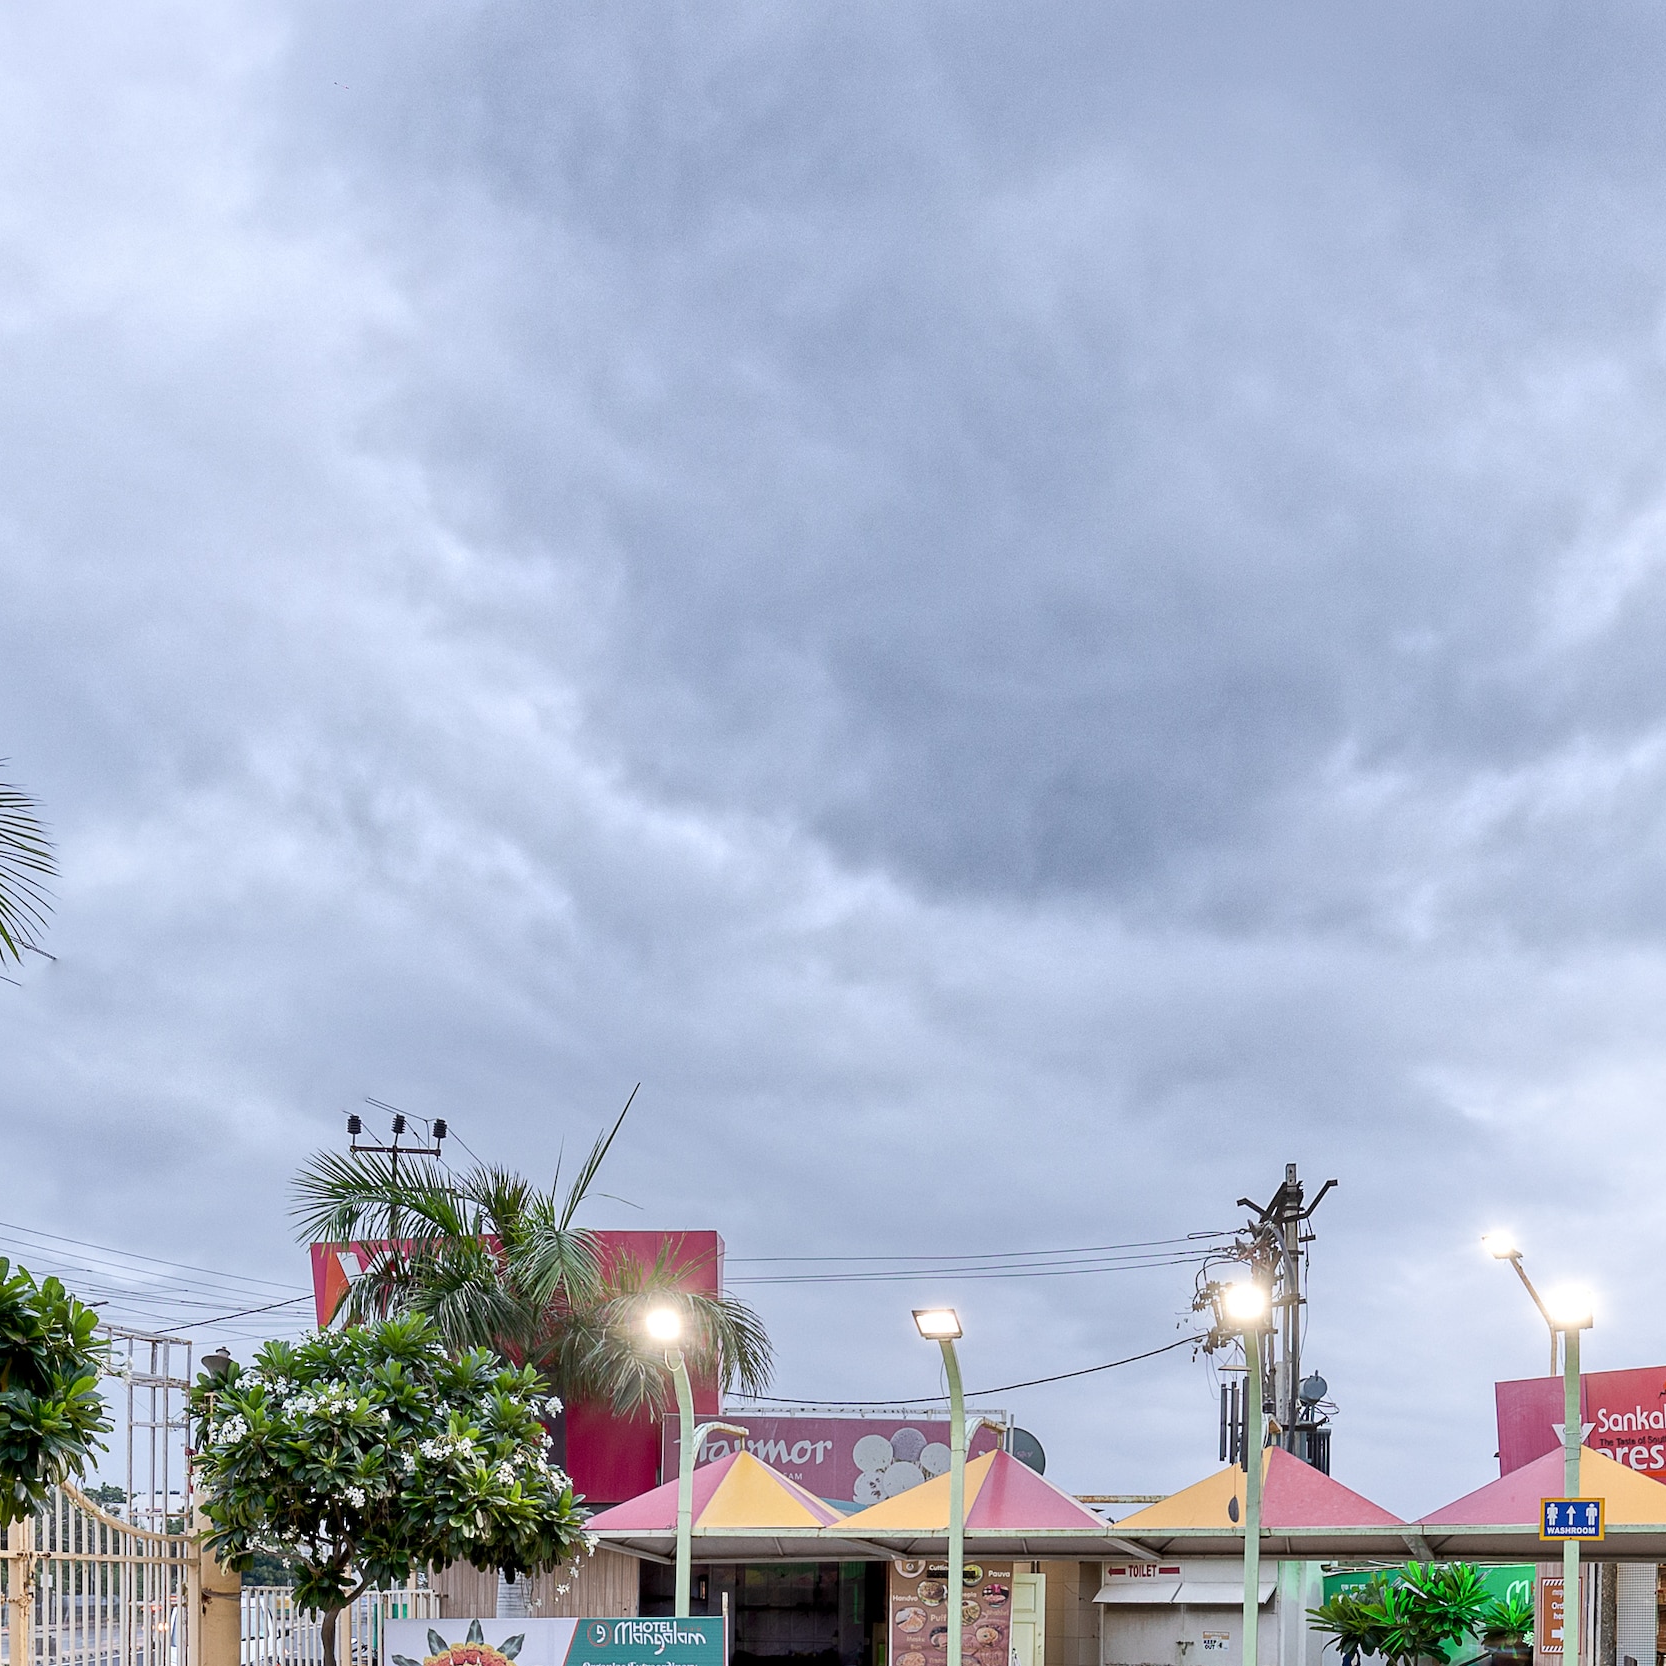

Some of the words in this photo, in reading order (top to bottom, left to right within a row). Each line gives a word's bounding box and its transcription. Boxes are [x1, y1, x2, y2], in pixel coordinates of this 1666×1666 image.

[1599, 1438, 1614, 1446] The
[1616, 1437, 1635, 1446] Taste
[1637, 1436, 1646, 1445] of
[1547, 1526, 1596, 1535] WASHROOM
[1128, 1564, 1157, 1577] TOILET
[633, 1621, 673, 1633] HOTEL
[614, 1621, 707, 1655] Mangalam
